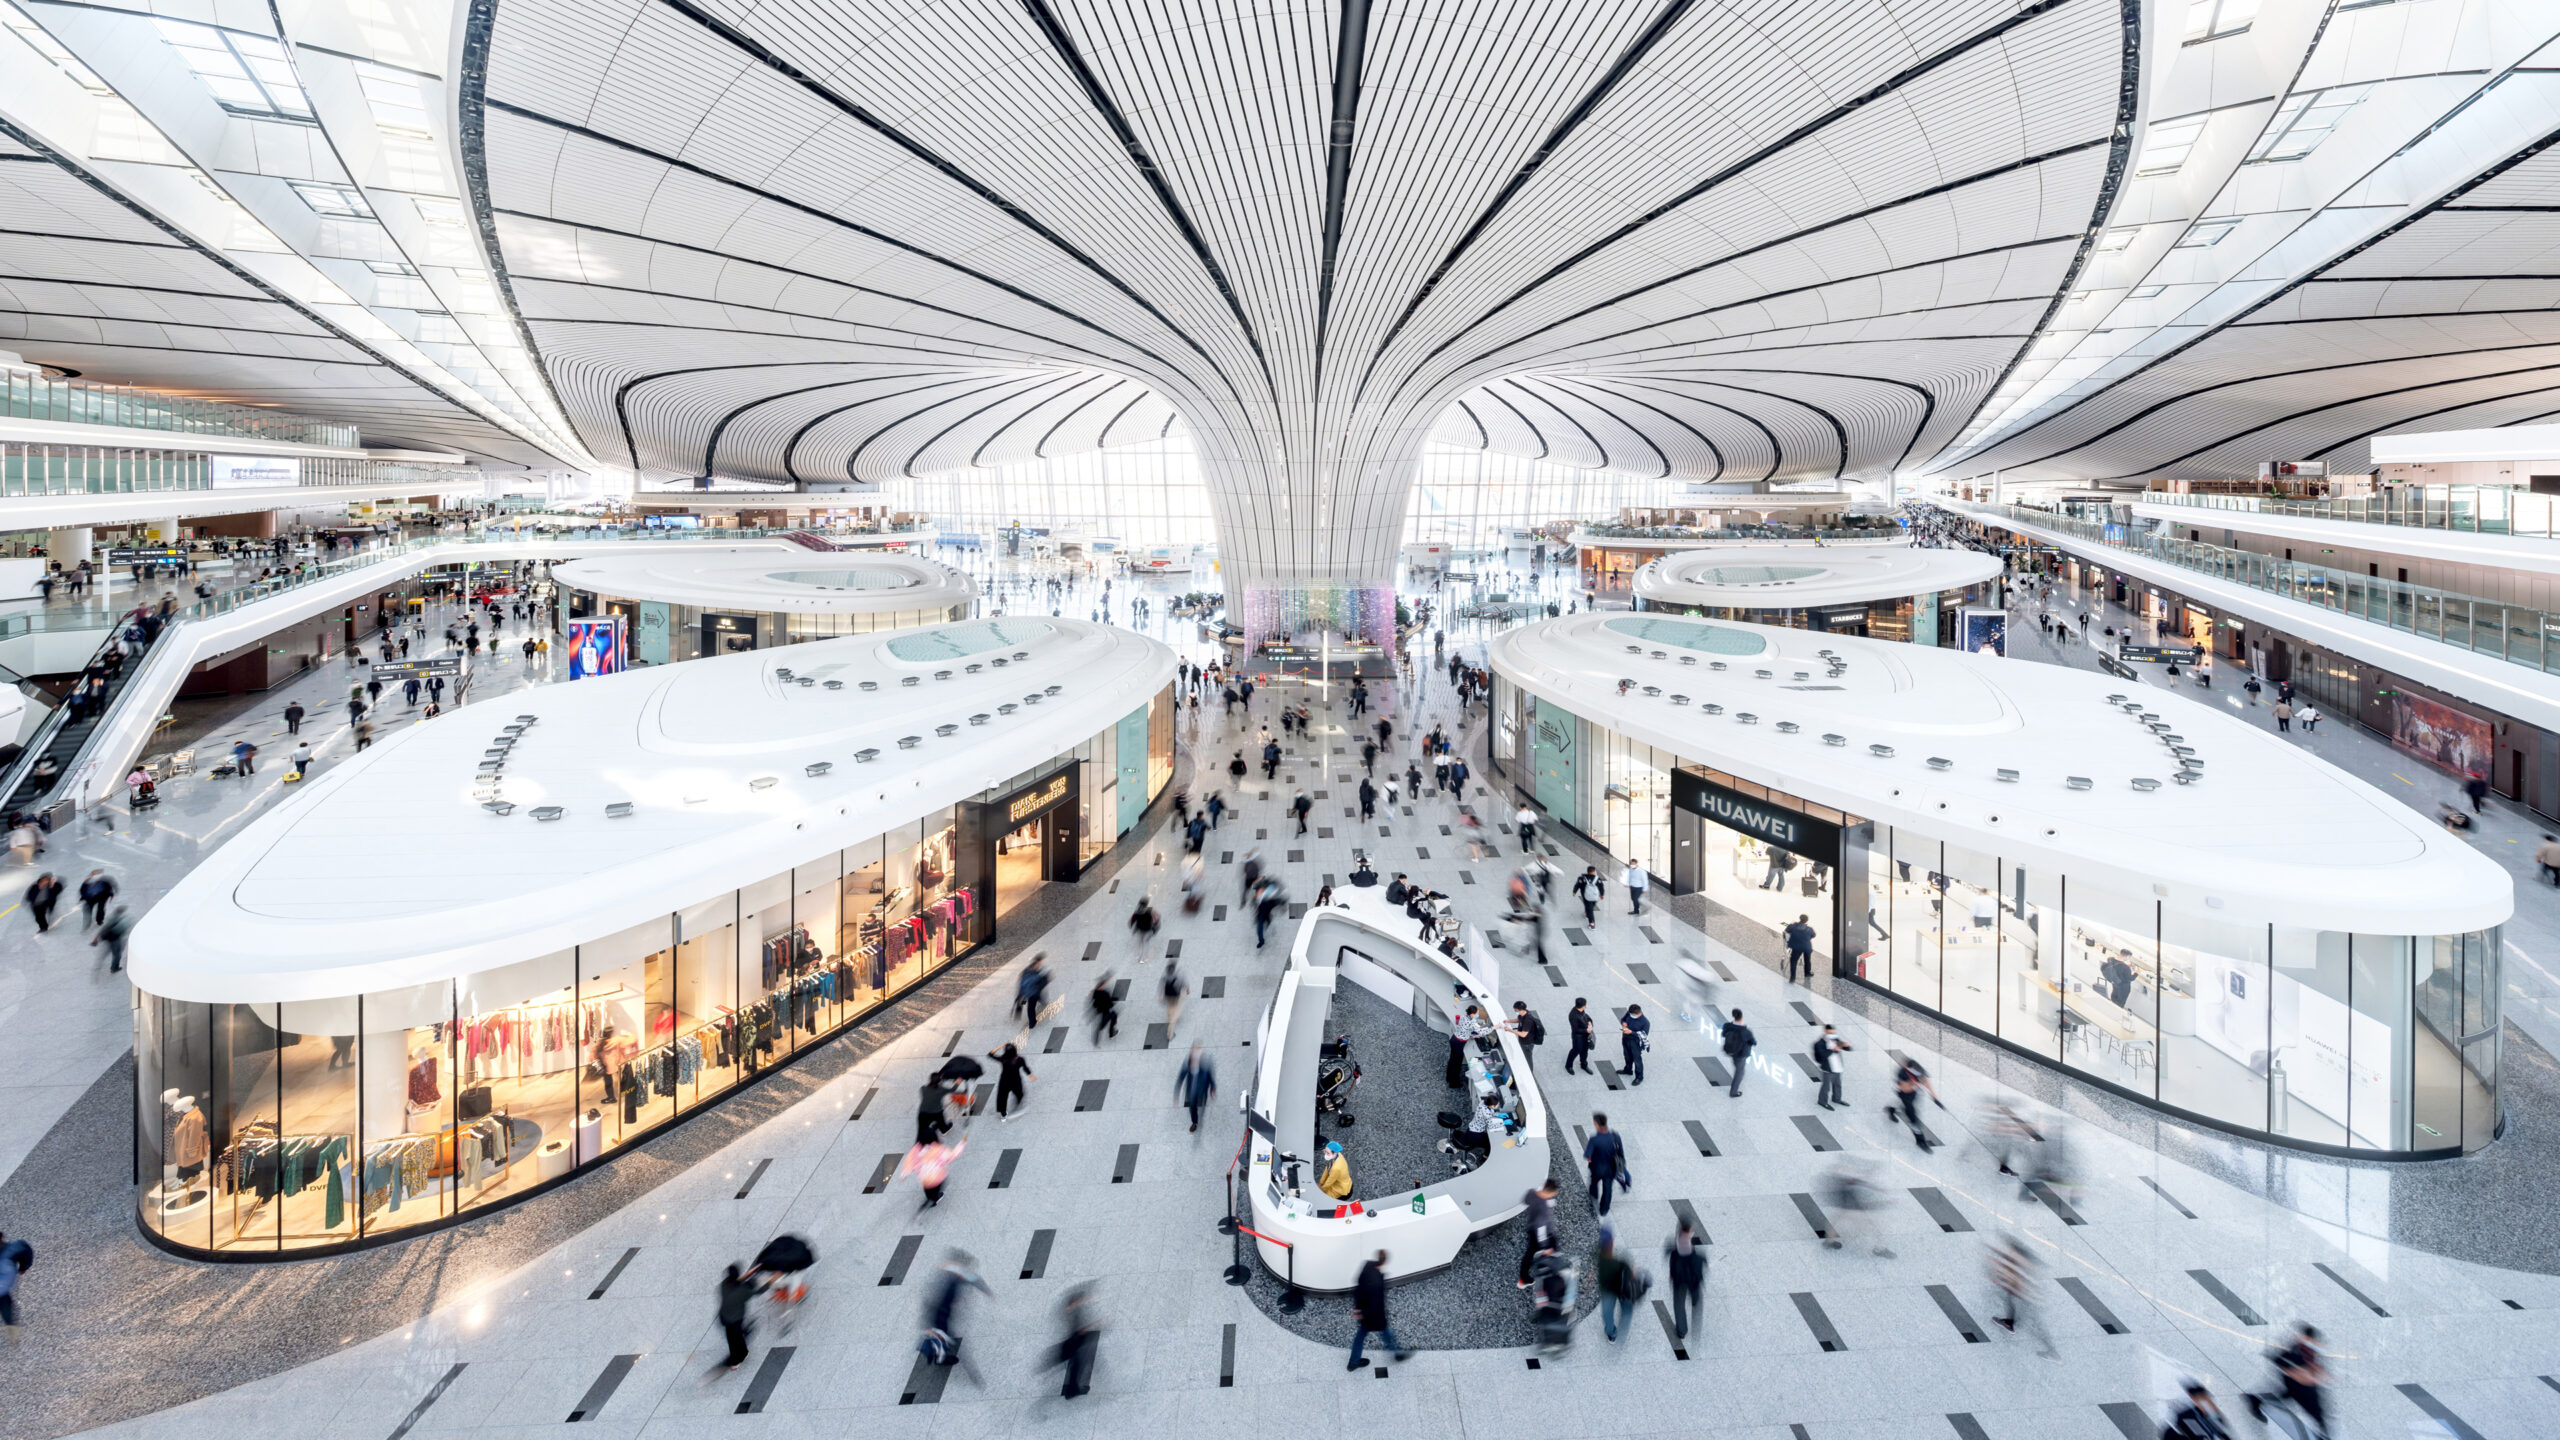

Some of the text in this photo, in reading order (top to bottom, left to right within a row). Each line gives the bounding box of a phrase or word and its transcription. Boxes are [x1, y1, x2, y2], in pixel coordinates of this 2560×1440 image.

[1830, 613, 1863, 623] STARBUCKS
[1010, 776, 1067, 812] DIANE VON
[1701, 791, 1795, 842] HUAWEI
[2305, 1033, 2338, 1055] HUAWEI
